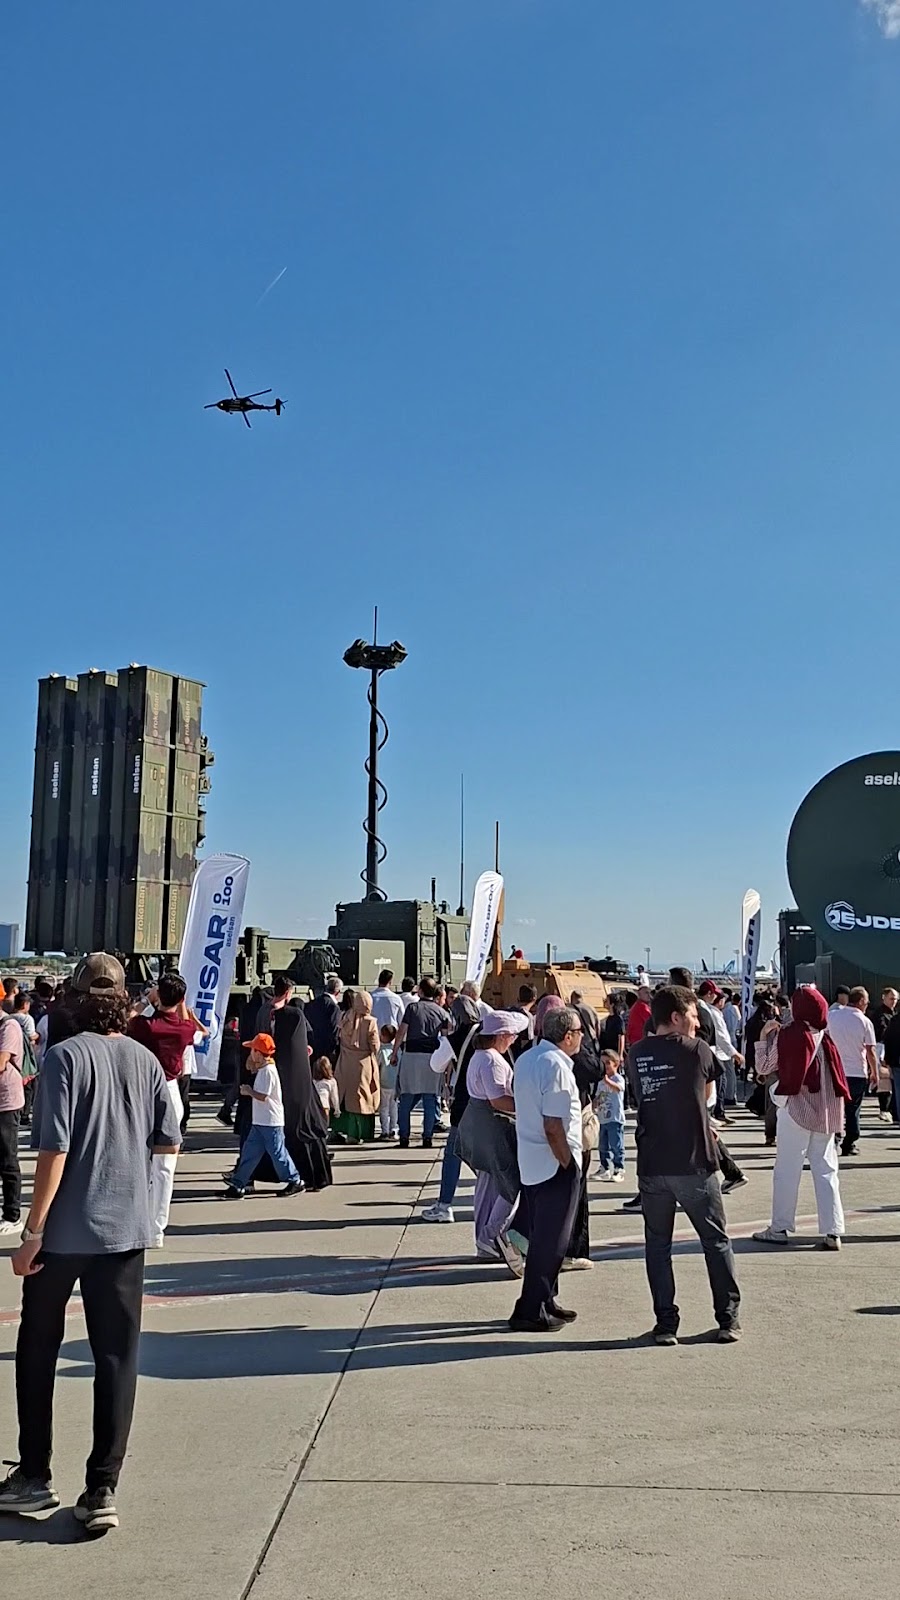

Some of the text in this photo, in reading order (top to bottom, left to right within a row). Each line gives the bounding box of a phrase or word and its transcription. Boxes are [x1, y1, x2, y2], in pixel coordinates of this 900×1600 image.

[51, 761, 60, 799] aselsan
[91, 757, 100, 796] aselsan
[132, 755, 141, 794] aselsan
[864, 771, 900, 786] asel
[222, 876, 234, 906] 100
[225, 916, 236, 948] aselsan
